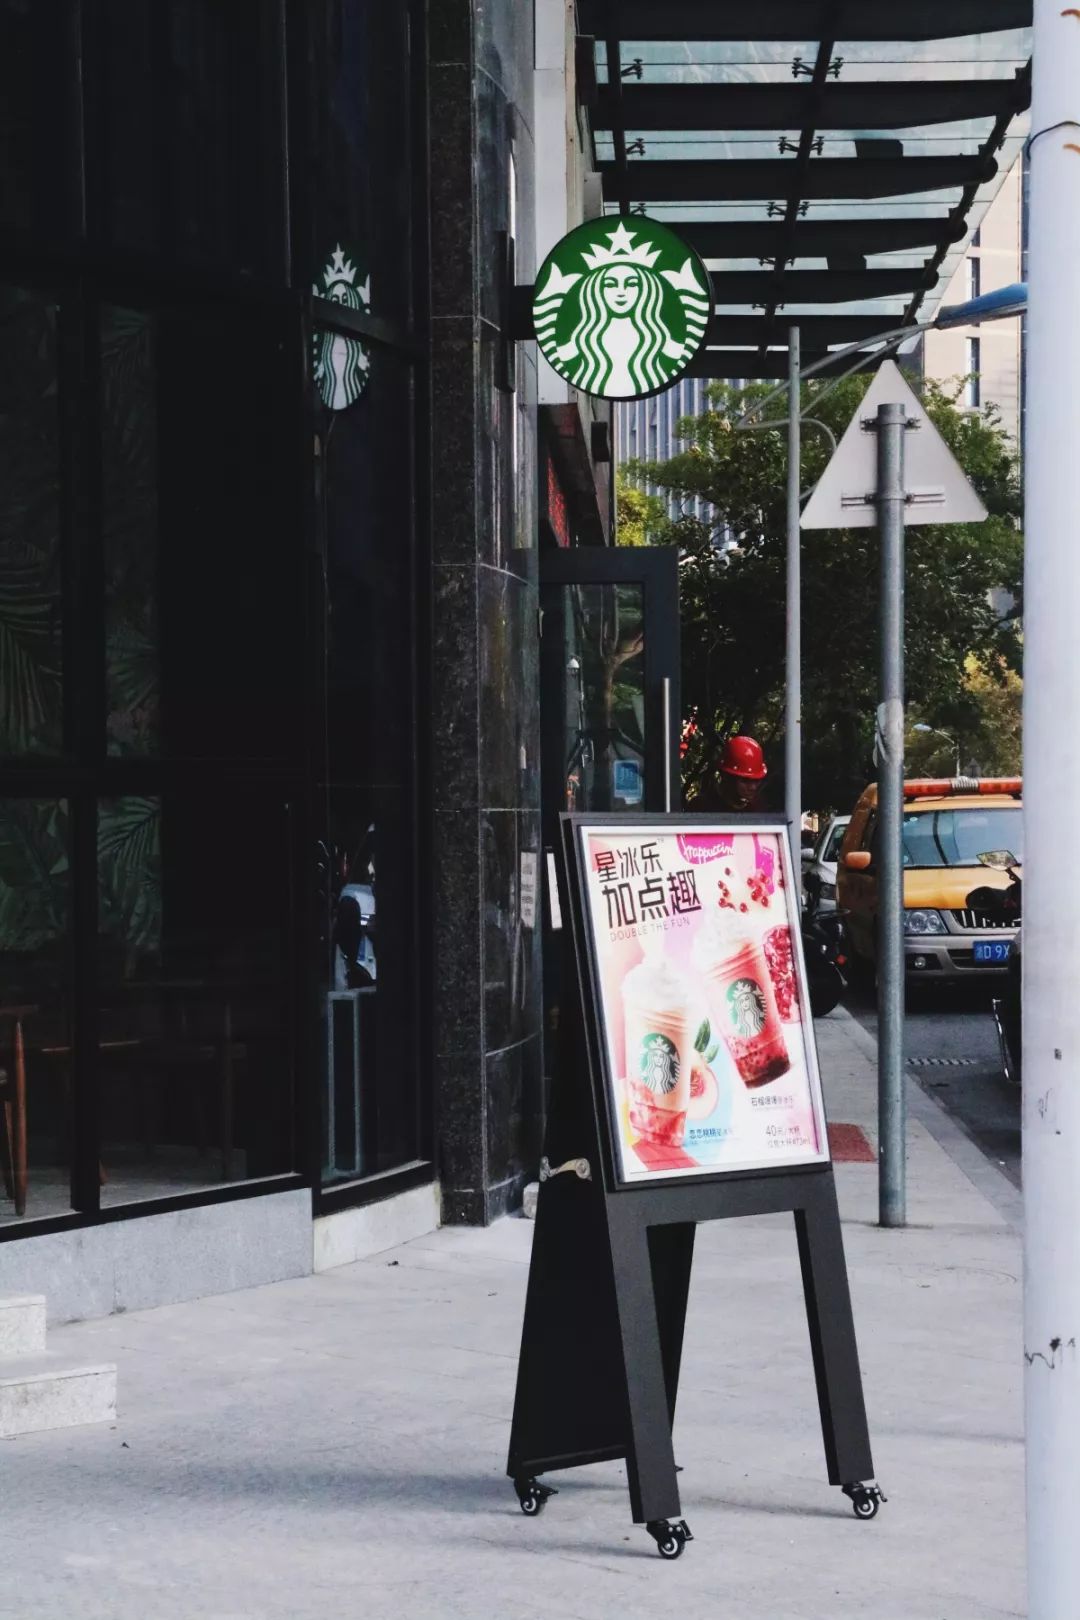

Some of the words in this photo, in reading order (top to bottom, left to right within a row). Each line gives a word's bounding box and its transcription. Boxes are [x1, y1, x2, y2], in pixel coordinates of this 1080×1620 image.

[594, 841, 664, 884] 星冰乐
[601, 868, 703, 929] 加点趣
[609, 924, 649, 942] DOUBLE
[651, 920, 669, 934] THE
[671, 916, 691, 929] FUN
